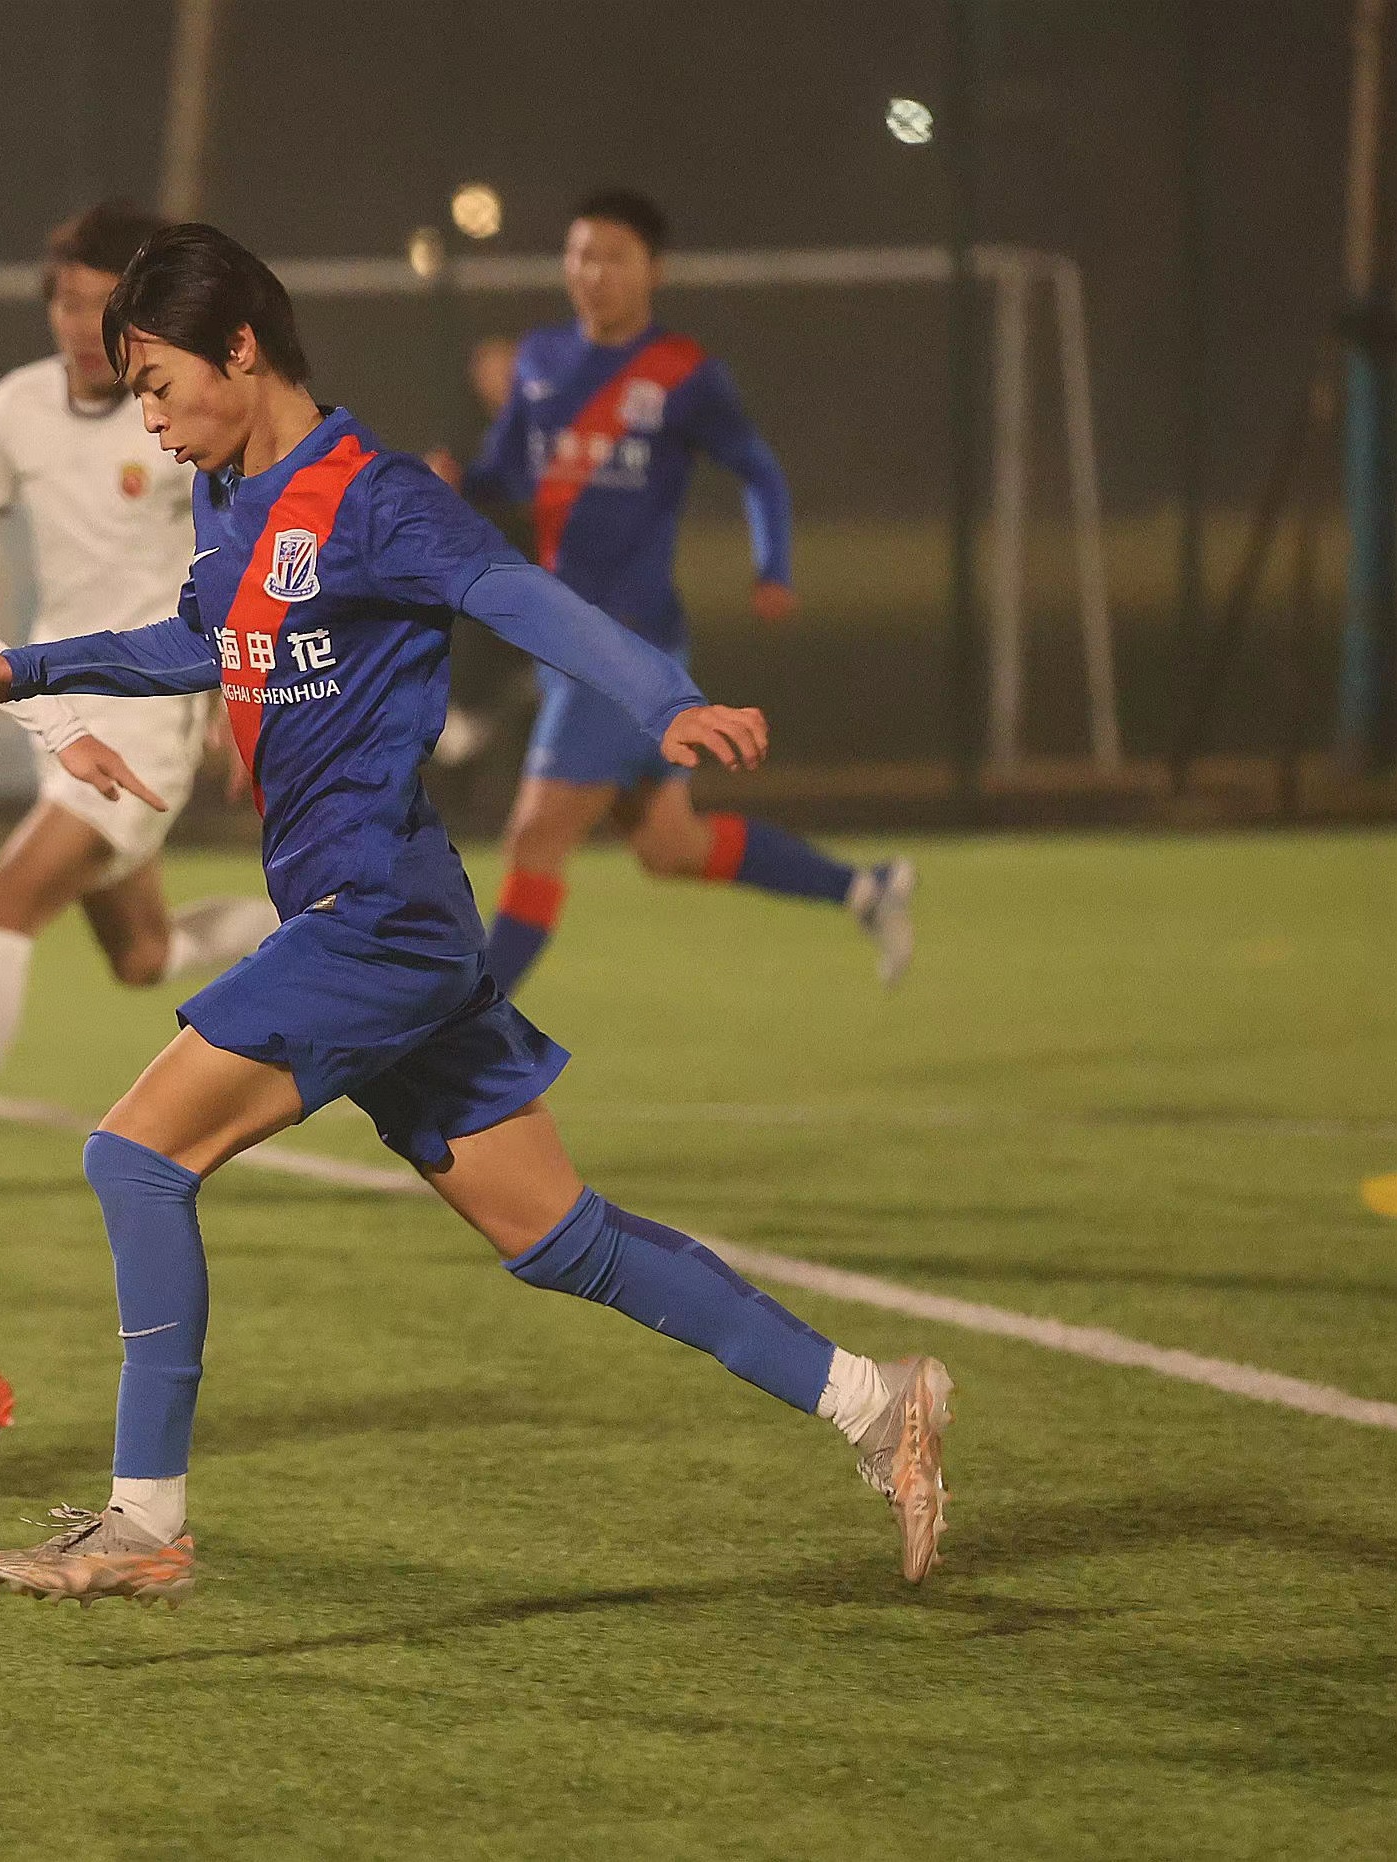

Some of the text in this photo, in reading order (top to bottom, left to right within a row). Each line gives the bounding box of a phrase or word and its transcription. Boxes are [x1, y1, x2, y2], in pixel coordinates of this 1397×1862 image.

[205, 626, 337, 673] 海申花
[252, 680, 341, 705] SHENHUA
